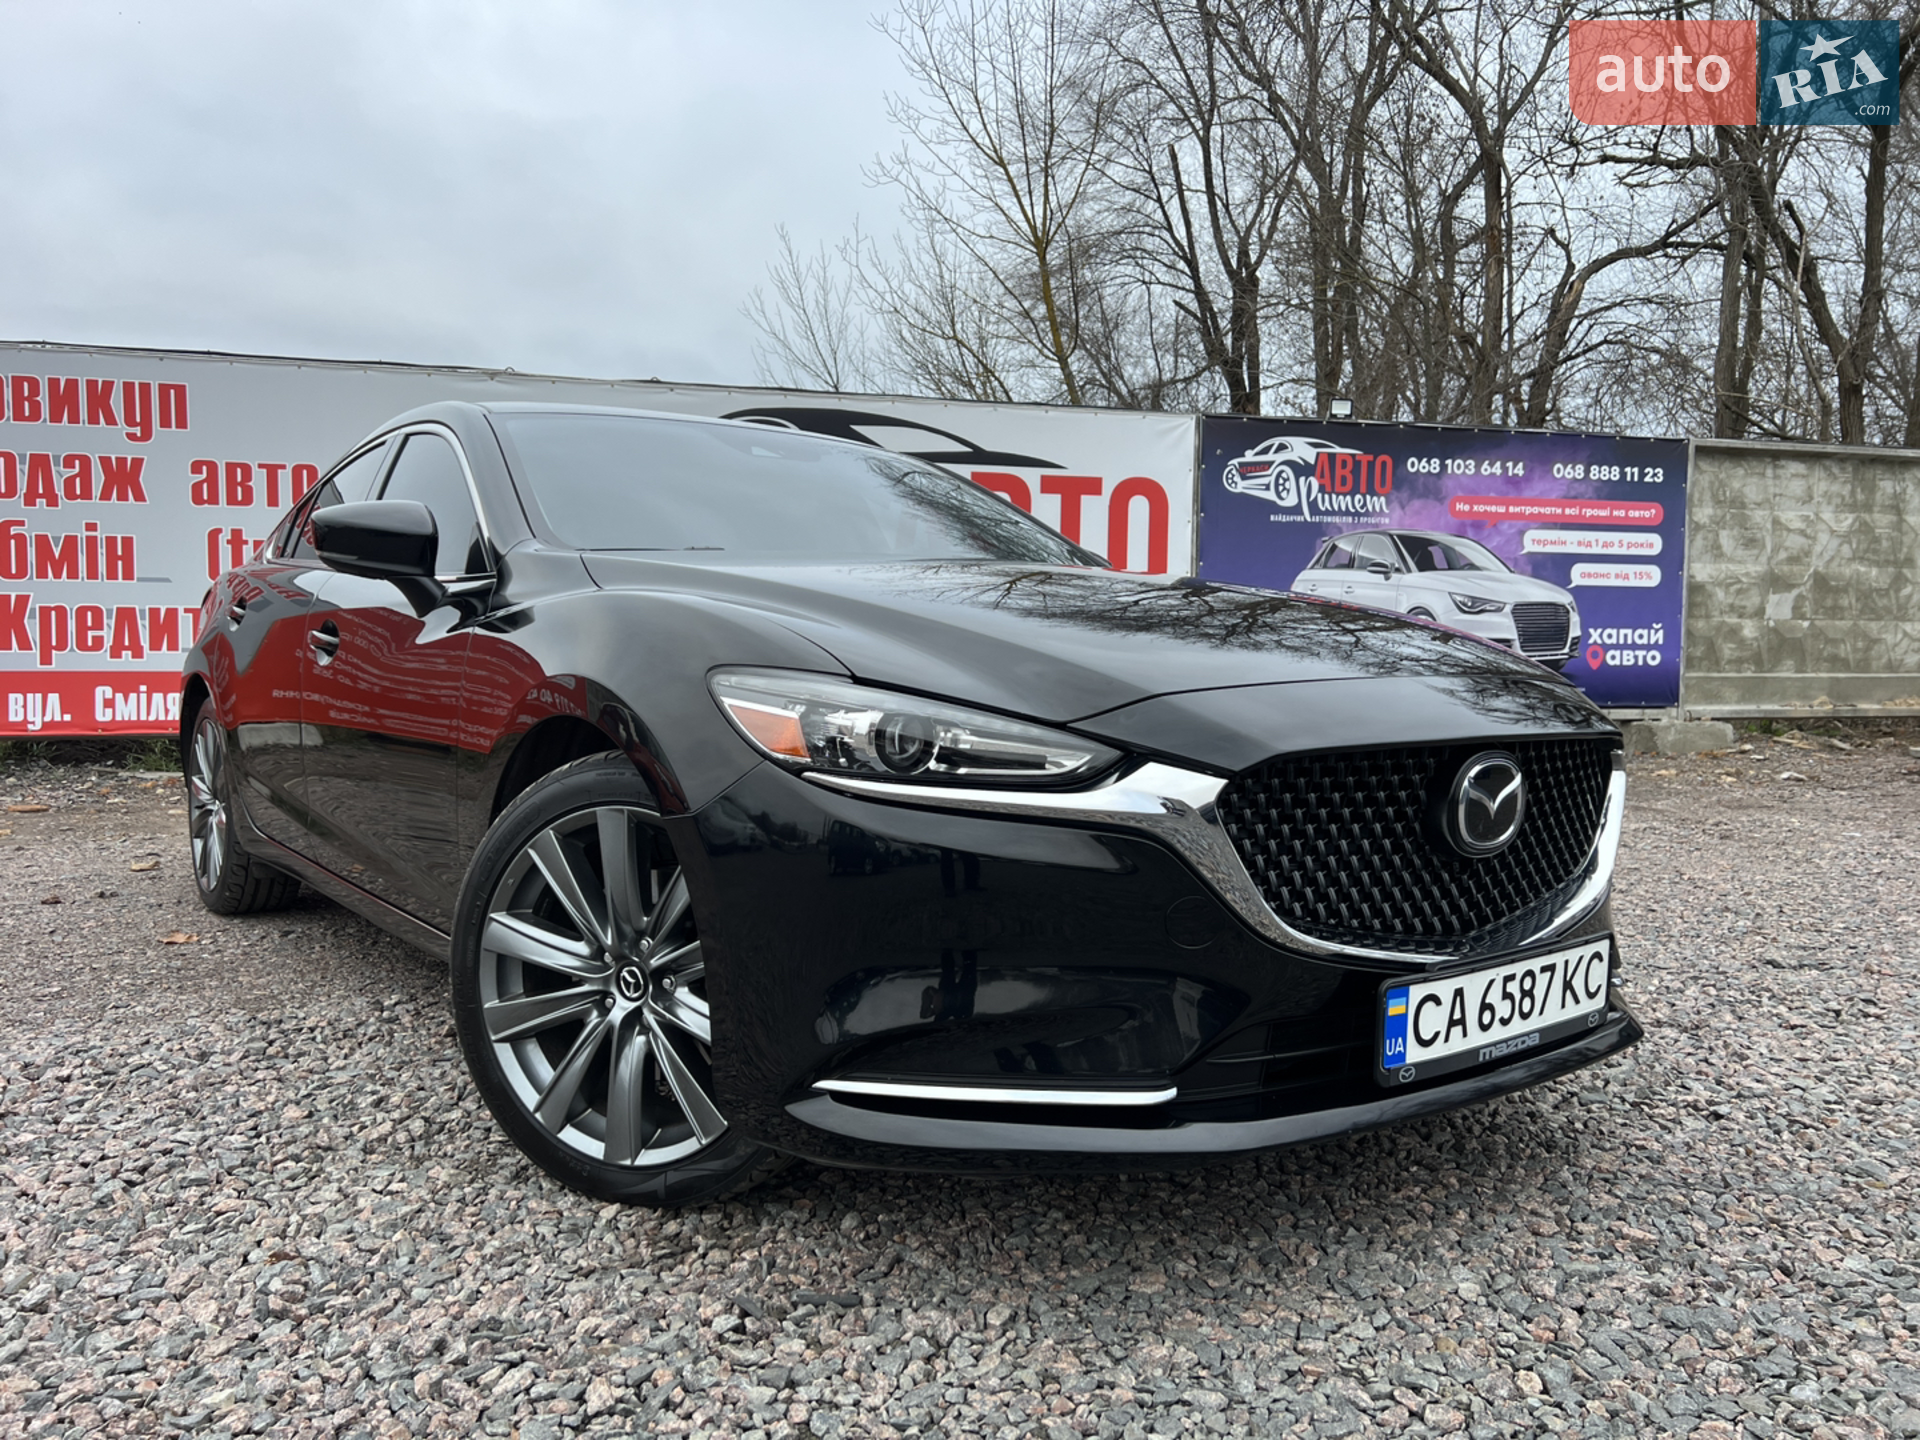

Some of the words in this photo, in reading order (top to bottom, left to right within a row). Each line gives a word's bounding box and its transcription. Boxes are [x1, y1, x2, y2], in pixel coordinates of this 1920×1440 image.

[0, 374, 190, 444] викуп
[1314, 451, 1393, 494] АВТО
[1407, 456, 1440, 473] 068
[1445, 459, 1475, 475] 103
[1480, 460, 1502, 476] 64
[1506, 461, 1525, 477] 14
[1553, 463, 1585, 479] 068
[1589, 465, 1620, 481] 888
[1624, 466, 1639, 481] 11
[1643, 467, 1664, 483] 23
[189, 458, 320, 508] авто
[1456, 502, 1470, 512] Не
[1472, 503, 1506, 513] хочеш
[1508, 505, 1562, 516] витрачати
[1564, 505, 1579, 515] всі
[1582, 506, 1610, 518] гроші
[1612, 508, 1626, 517] на
[1628, 509, 1656, 519] авто?
[1531, 538, 1567, 548] термін
[1577, 539, 1592, 549] від
[1595, 539, 1599, 547] 1
[1602, 541, 1615, 549] до
[1618, 540, 1624, 548] 5
[1627, 540, 1654, 550] років
[1580, 571, 1611, 580] аванс
[1614, 570, 1630, 580] від
[1633, 571, 1653, 581] 15%
[1588, 623, 1664, 645] хапай
[1605, 649, 1662, 666] авто
[8, 693, 72, 731] вул.
[1413, 986, 1468, 1048] CA
[1477, 962, 1557, 1033] 6587
[1560, 950, 1604, 1010] KC
[1386, 1036, 1405, 1056] UA
